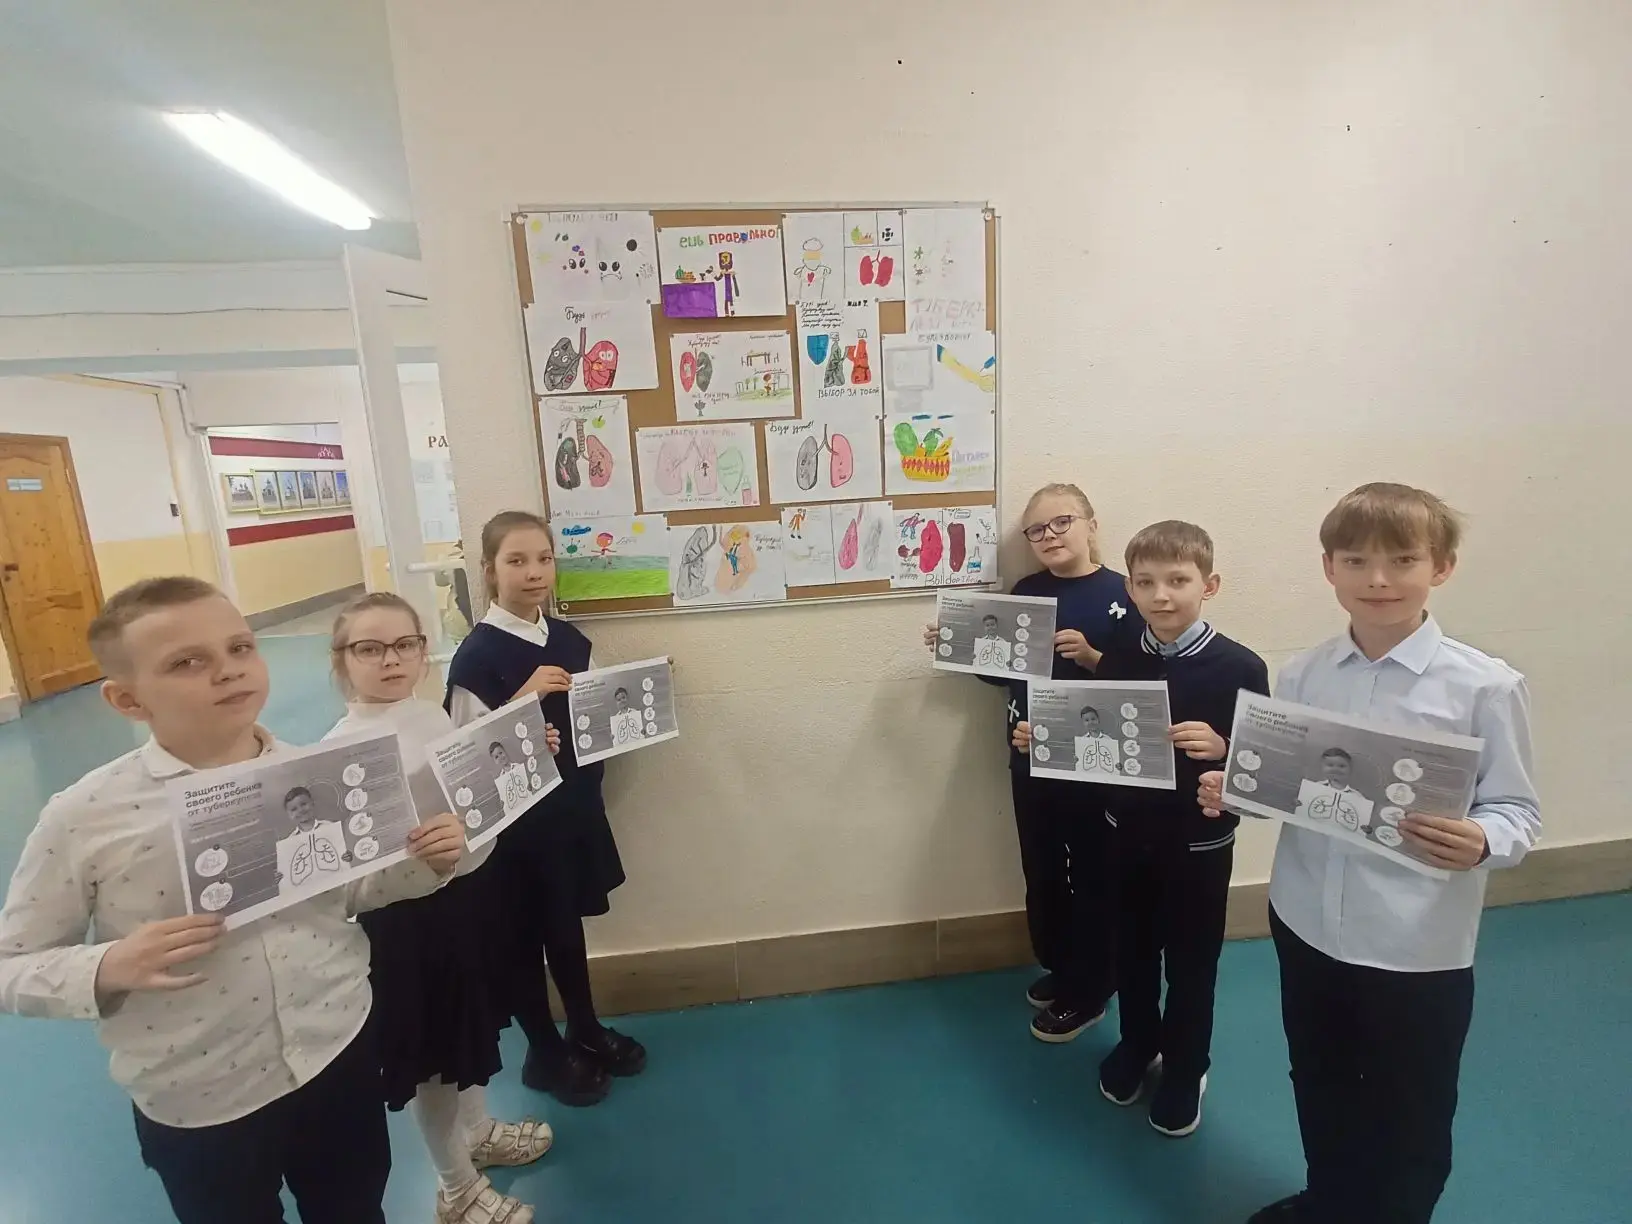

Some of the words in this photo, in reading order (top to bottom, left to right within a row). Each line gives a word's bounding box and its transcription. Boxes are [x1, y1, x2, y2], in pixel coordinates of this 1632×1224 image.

[184, 781, 236, 800] Защитите
[185, 794, 222, 809] своего
[223, 782, 262, 799] ребенка
[187, 807, 201, 818] от
